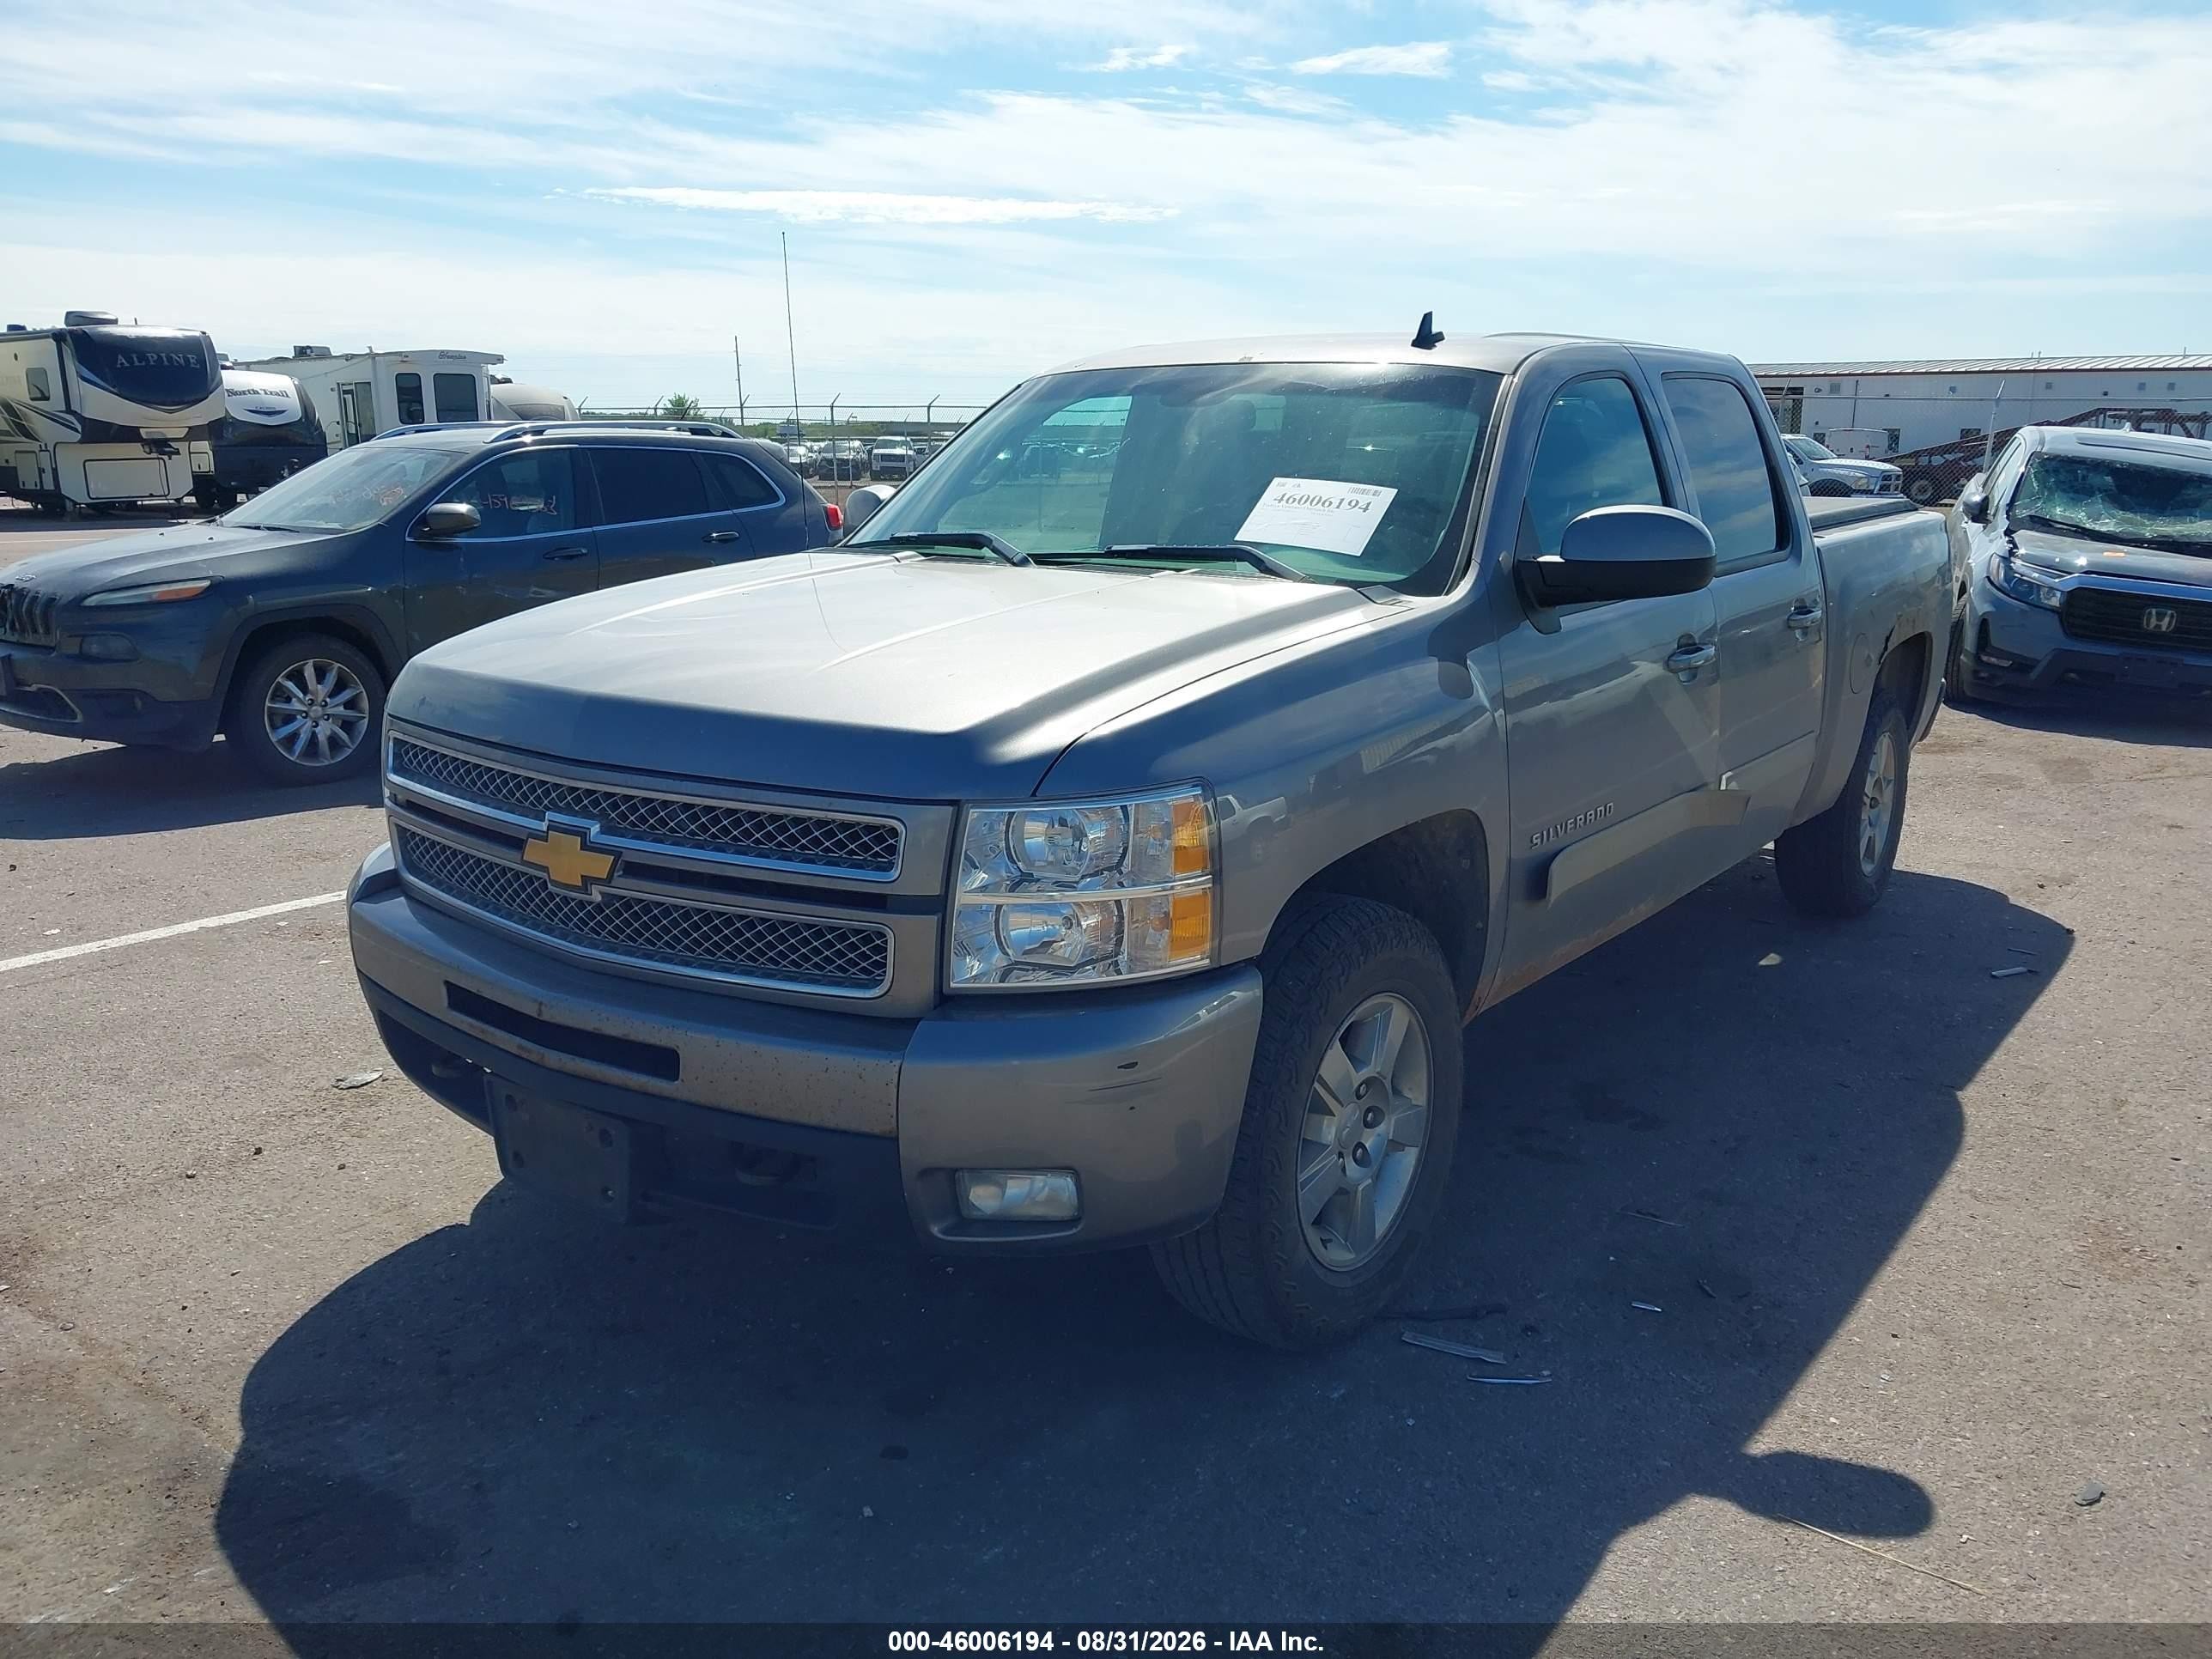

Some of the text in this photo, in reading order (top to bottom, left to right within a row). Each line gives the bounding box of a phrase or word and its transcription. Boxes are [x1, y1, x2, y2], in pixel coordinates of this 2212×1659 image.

[116, 353, 200, 368] ALPINE
[225, 388, 290, 398] North Trail
[1273, 492, 1372, 514] 46006194
[1530, 802, 1614, 849] SILVERADO
